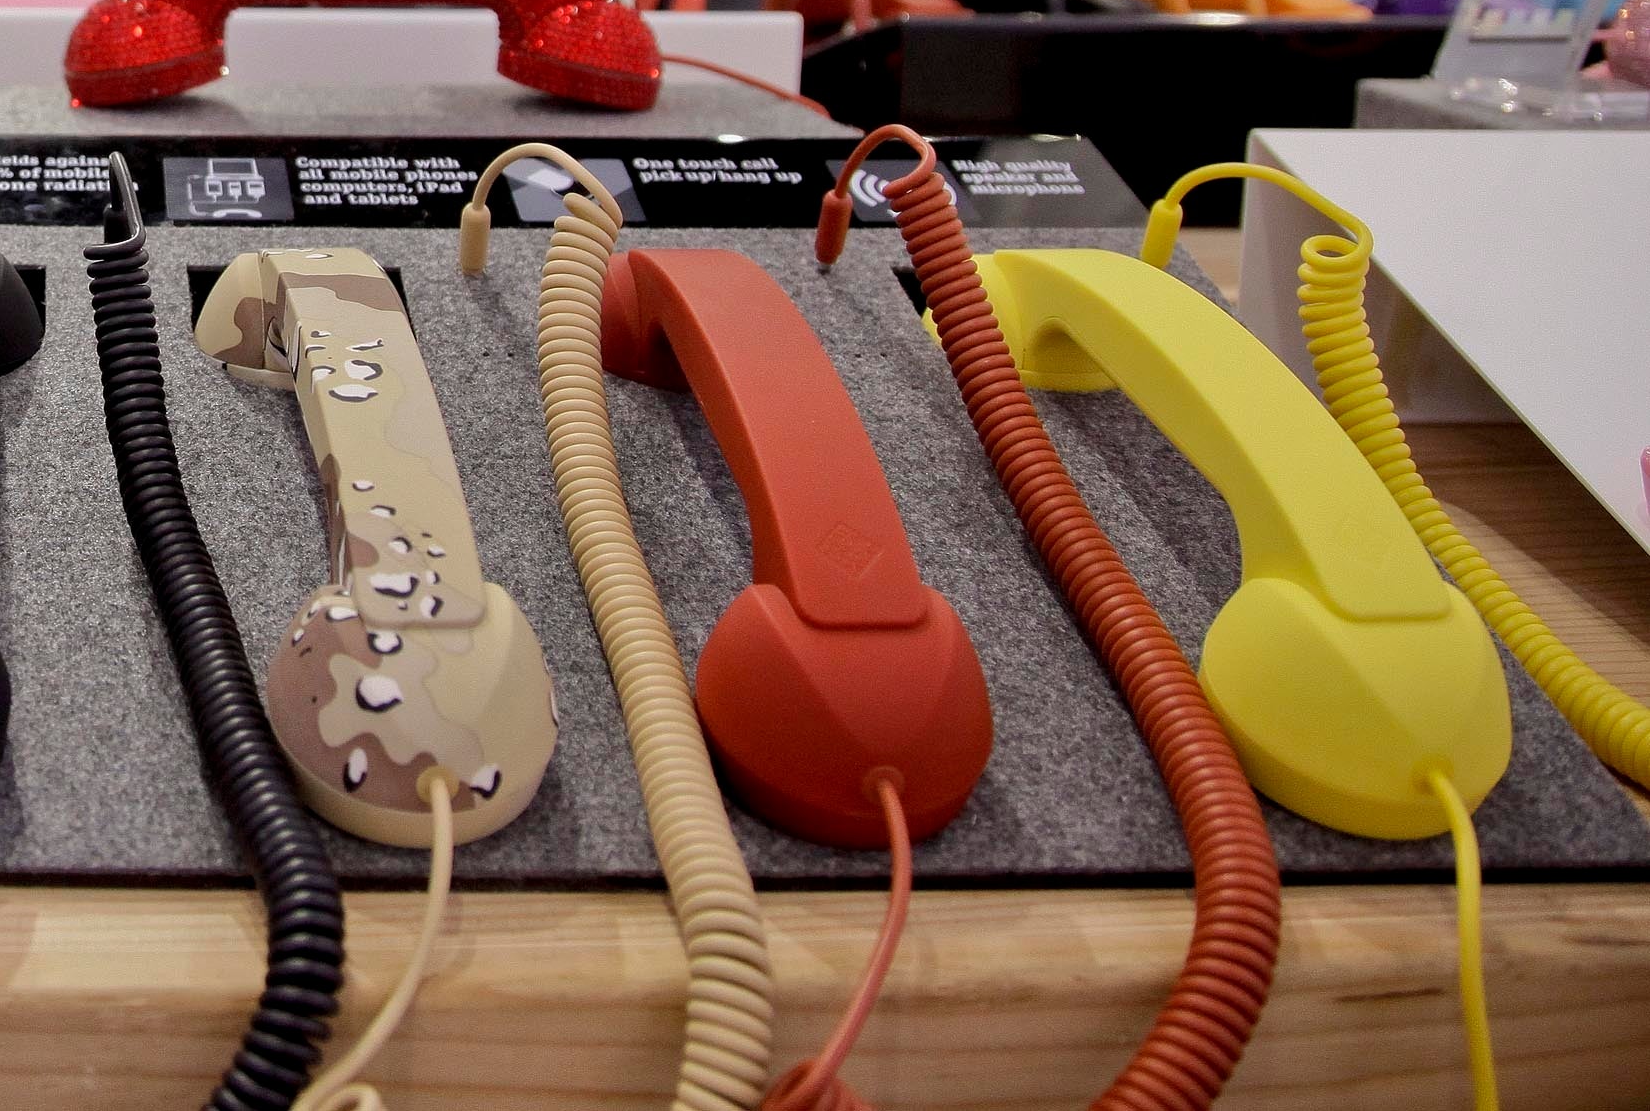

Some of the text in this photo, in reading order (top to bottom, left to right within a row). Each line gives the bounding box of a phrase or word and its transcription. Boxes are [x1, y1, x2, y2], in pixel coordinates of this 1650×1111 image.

[44, 154, 110, 169] agains
[295, 156, 461, 170] Compatible with
[632, 157, 779, 170] One touch call
[951, 159, 1072, 173] High quality
[19, 167, 42, 179] of
[298, 169, 478, 182] all mobile phones
[639, 170, 803, 184] pick up/hang up
[961, 171, 1080, 185] speaker and
[300, 181, 464, 194] computers, iPad
[968, 183, 1086, 196] microphone
[303, 193, 419, 205] and tablets
